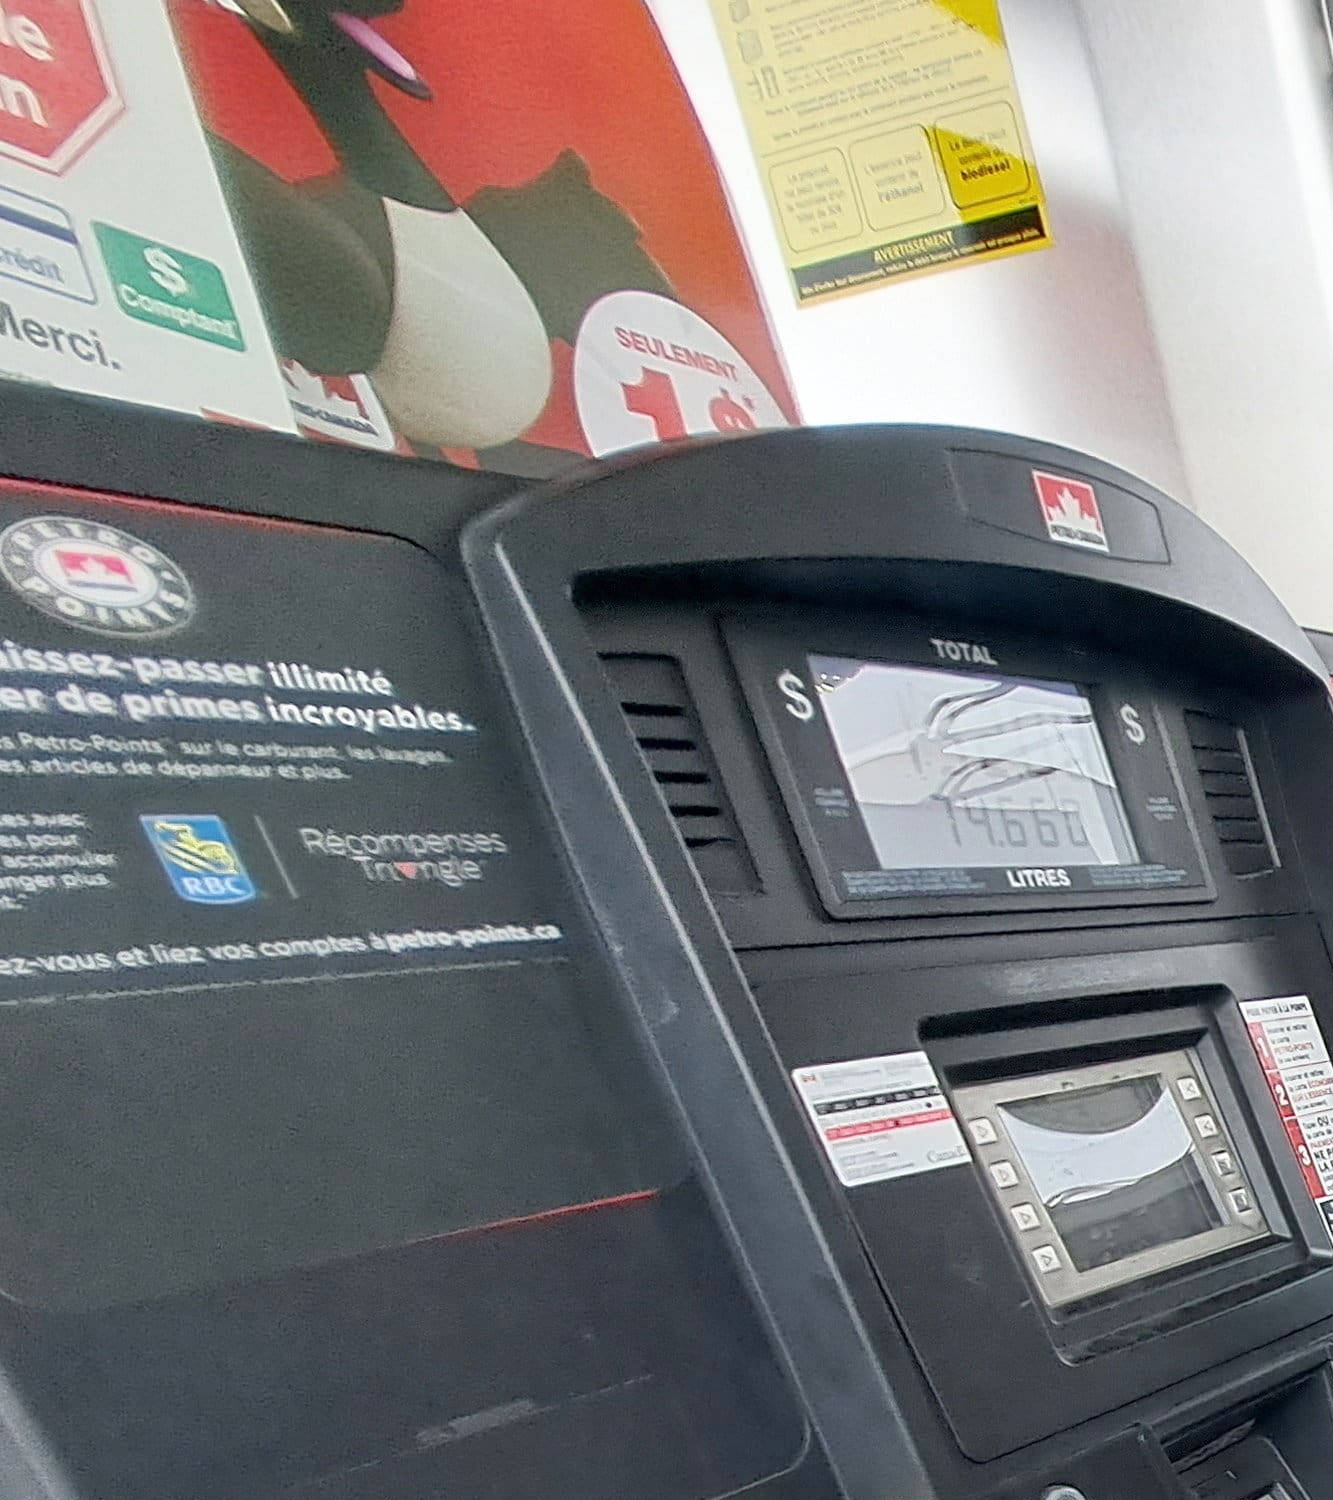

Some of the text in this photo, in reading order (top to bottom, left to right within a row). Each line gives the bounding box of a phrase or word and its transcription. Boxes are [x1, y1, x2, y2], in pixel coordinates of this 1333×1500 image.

[874, 230, 954, 263] AVERTISSEMENT
[0, 248, 64, 284] rédit
[615, 327, 738, 382] SEULEMENT
[930, 637, 999, 666] TOTAL
[266, 661, 393, 697] illimité
[56, 683, 116, 715] de
[121, 689, 262, 723] primes
[264, 694, 477, 734] incroyables.
[122, 758, 152, 775] de
[299, 827, 508, 857] Récompenses
[181, 876, 247, 896] RBC
[1007, 869, 1070, 889] LITRES
[116, 947, 151, 967] et
[151, 943, 206, 965] liez
[206, 943, 257, 961] vos
[258, 935, 369, 957] comptes
[1255, 1036, 1270, 1058] 1
[1273, 1084, 1289, 1106] 2
[1316, 1115, 1330, 1126] OU
[1296, 1143, 1313, 1166] 3
[1313, 1149, 1326, 1161] NE
[1317, 1161, 1331, 1173] LA
